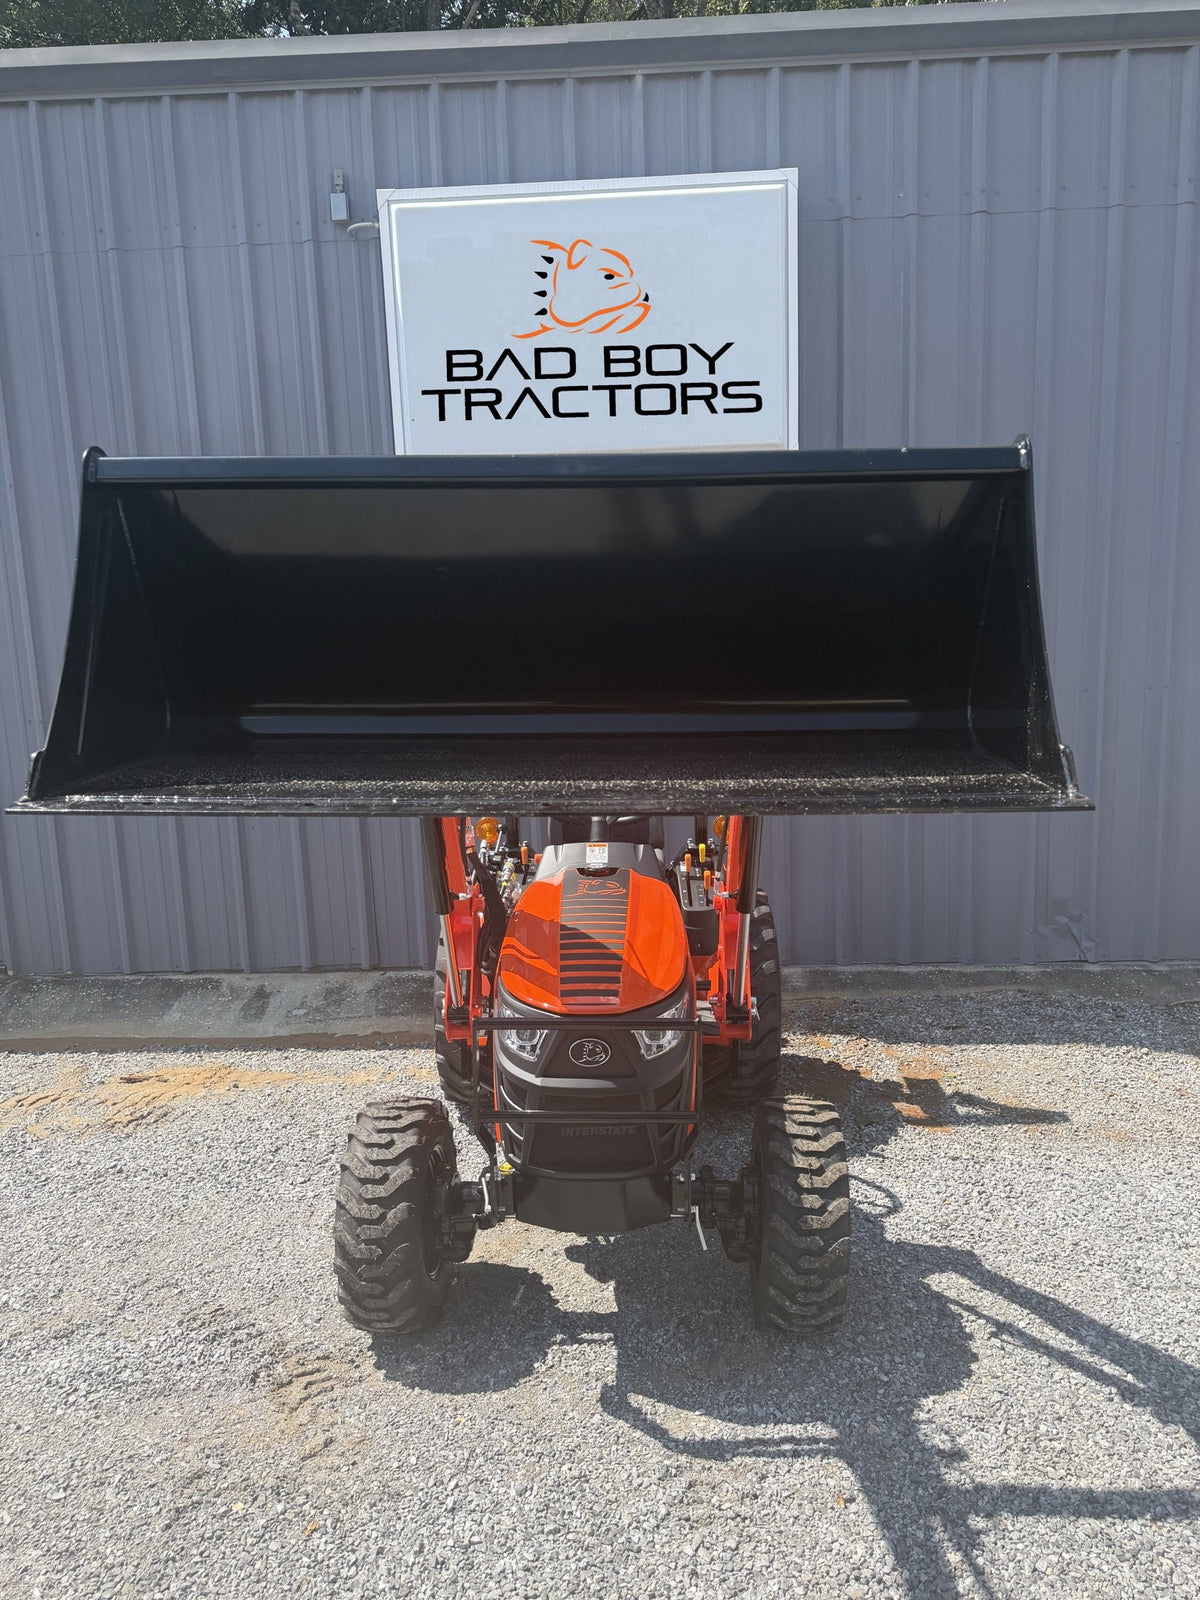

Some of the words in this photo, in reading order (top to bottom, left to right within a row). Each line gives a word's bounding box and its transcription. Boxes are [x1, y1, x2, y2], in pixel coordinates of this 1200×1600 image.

[446, 347, 577, 382] BAD
[603, 342, 735, 378] BOY
[421, 380, 763, 421] TRACTORS
[561, 1125, 637, 1137] INTERSTATE
